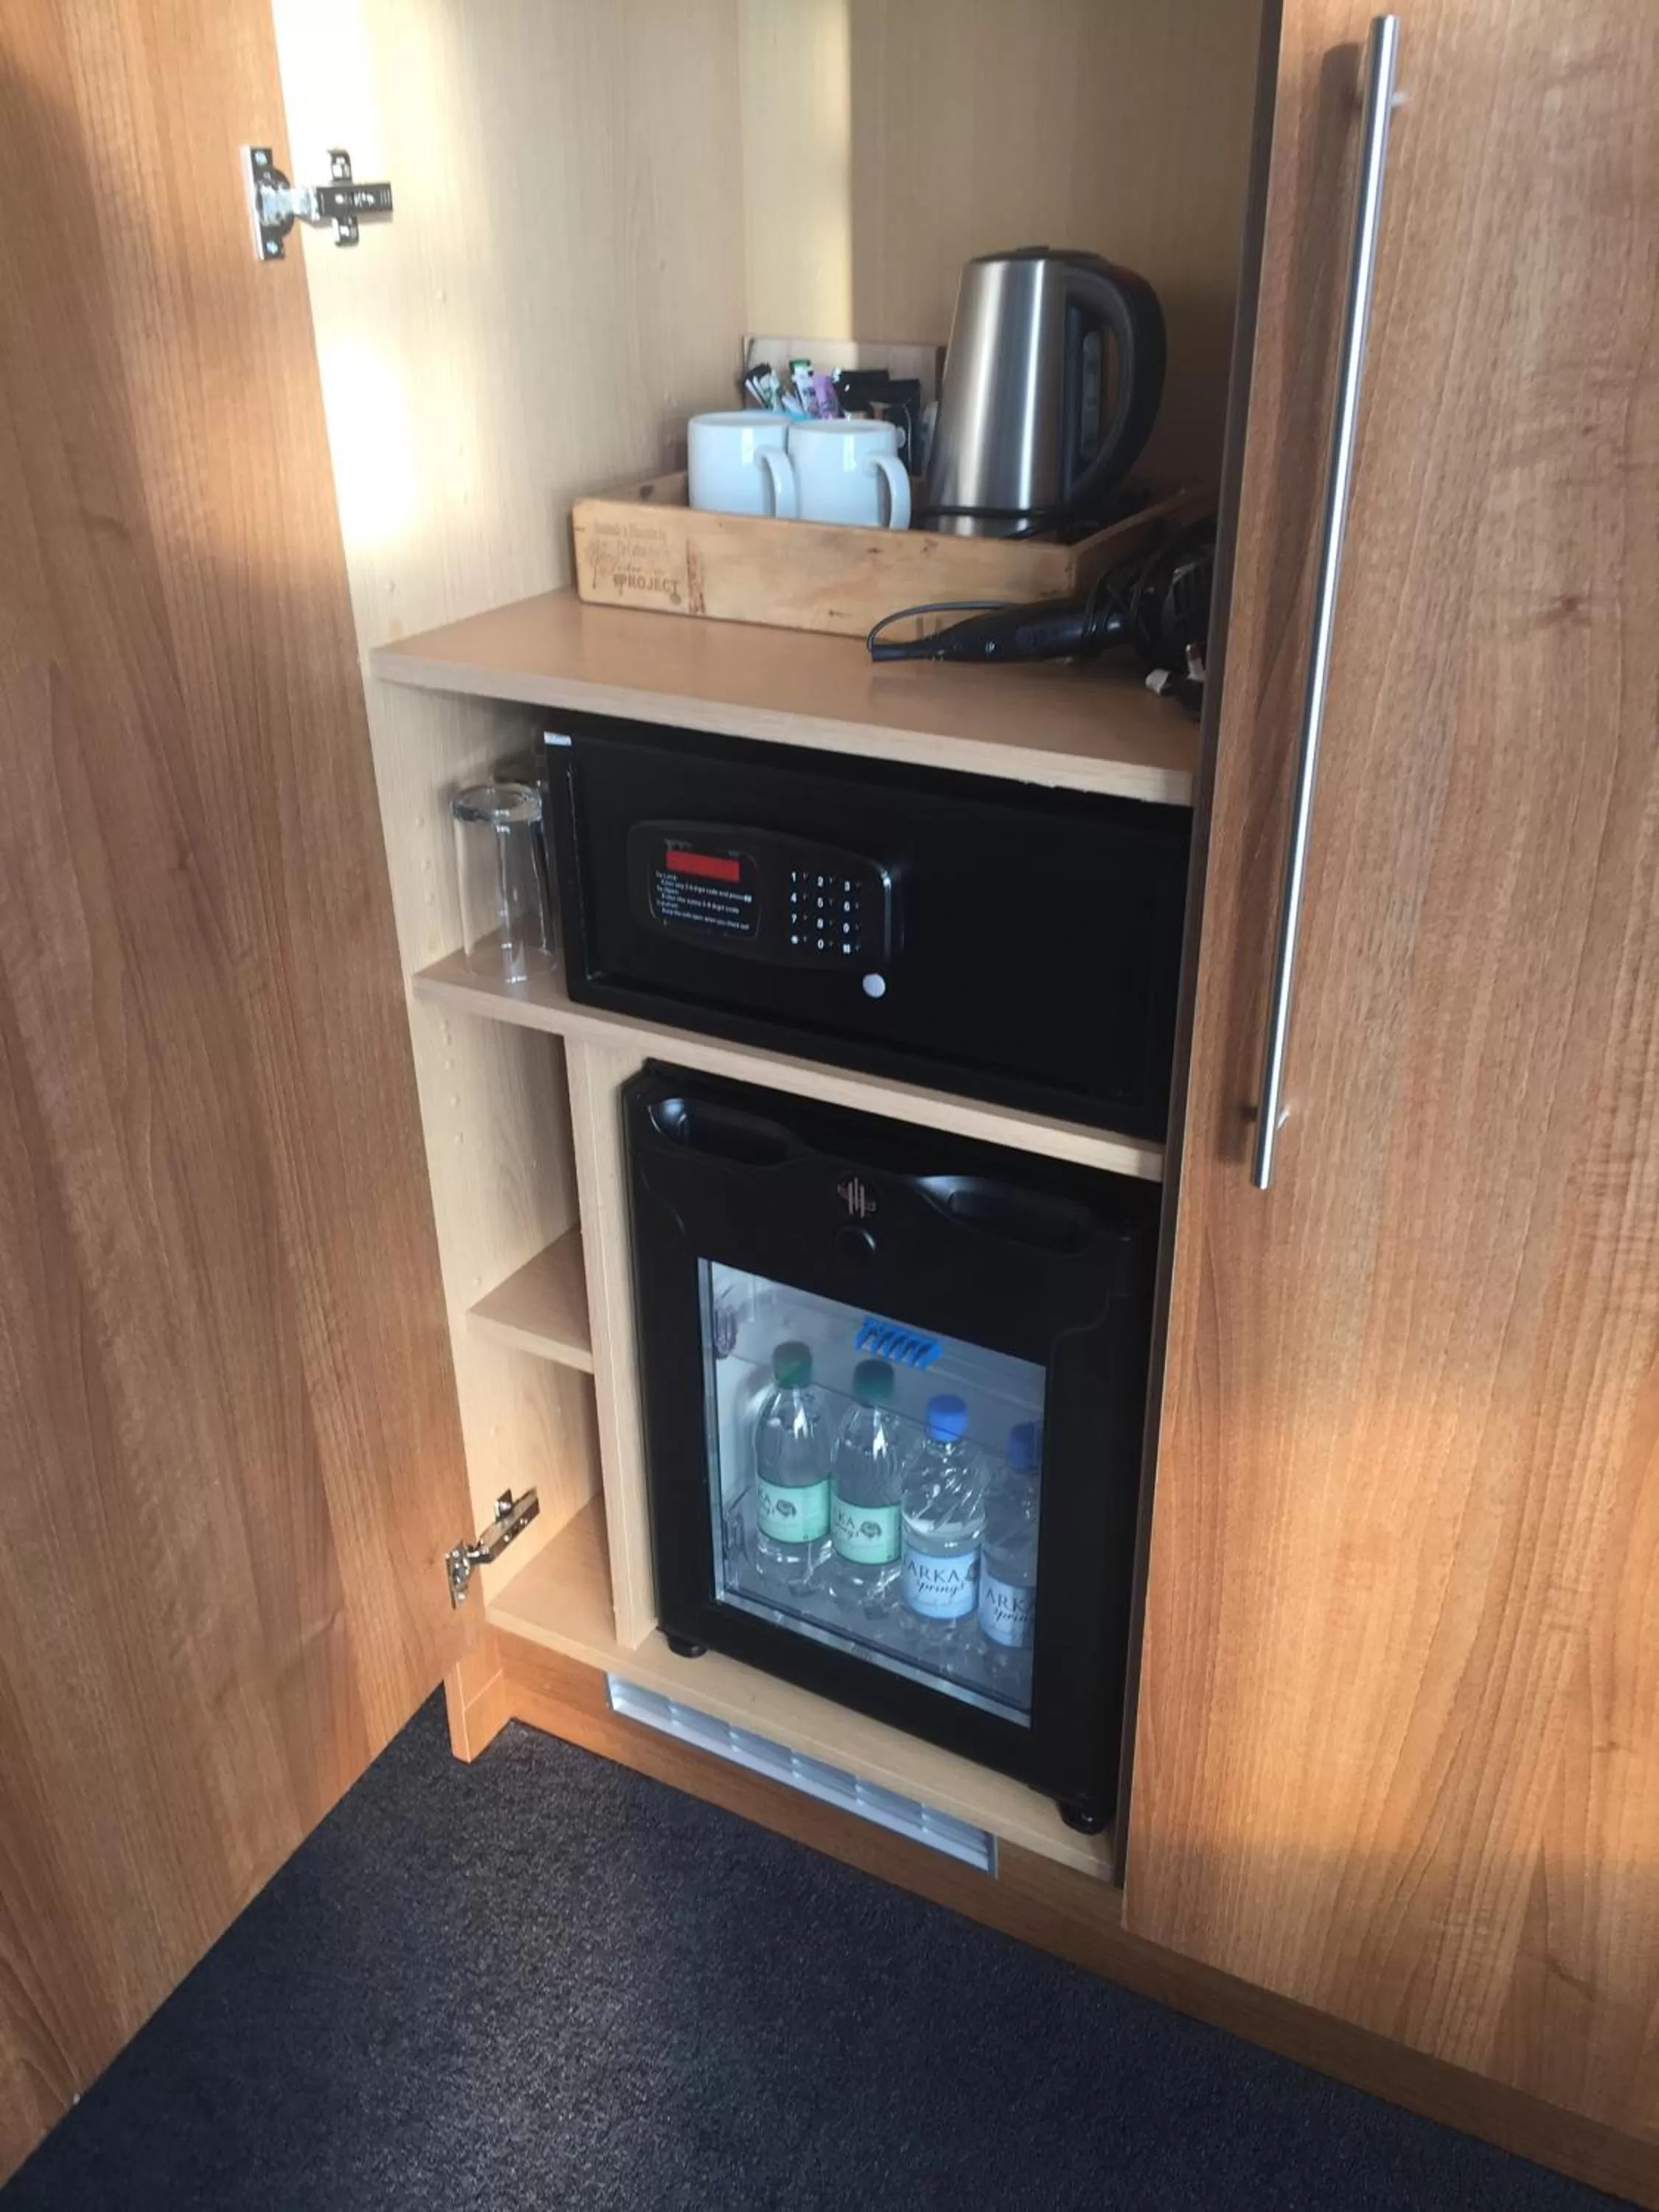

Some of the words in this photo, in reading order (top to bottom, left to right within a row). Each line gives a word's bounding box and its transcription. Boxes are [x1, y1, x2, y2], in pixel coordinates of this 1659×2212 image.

[791, 871, 796, 883] 1
[790, 891, 797, 903] 4
[791, 913, 797, 925] 7
[817, 938, 824, 950] 0
